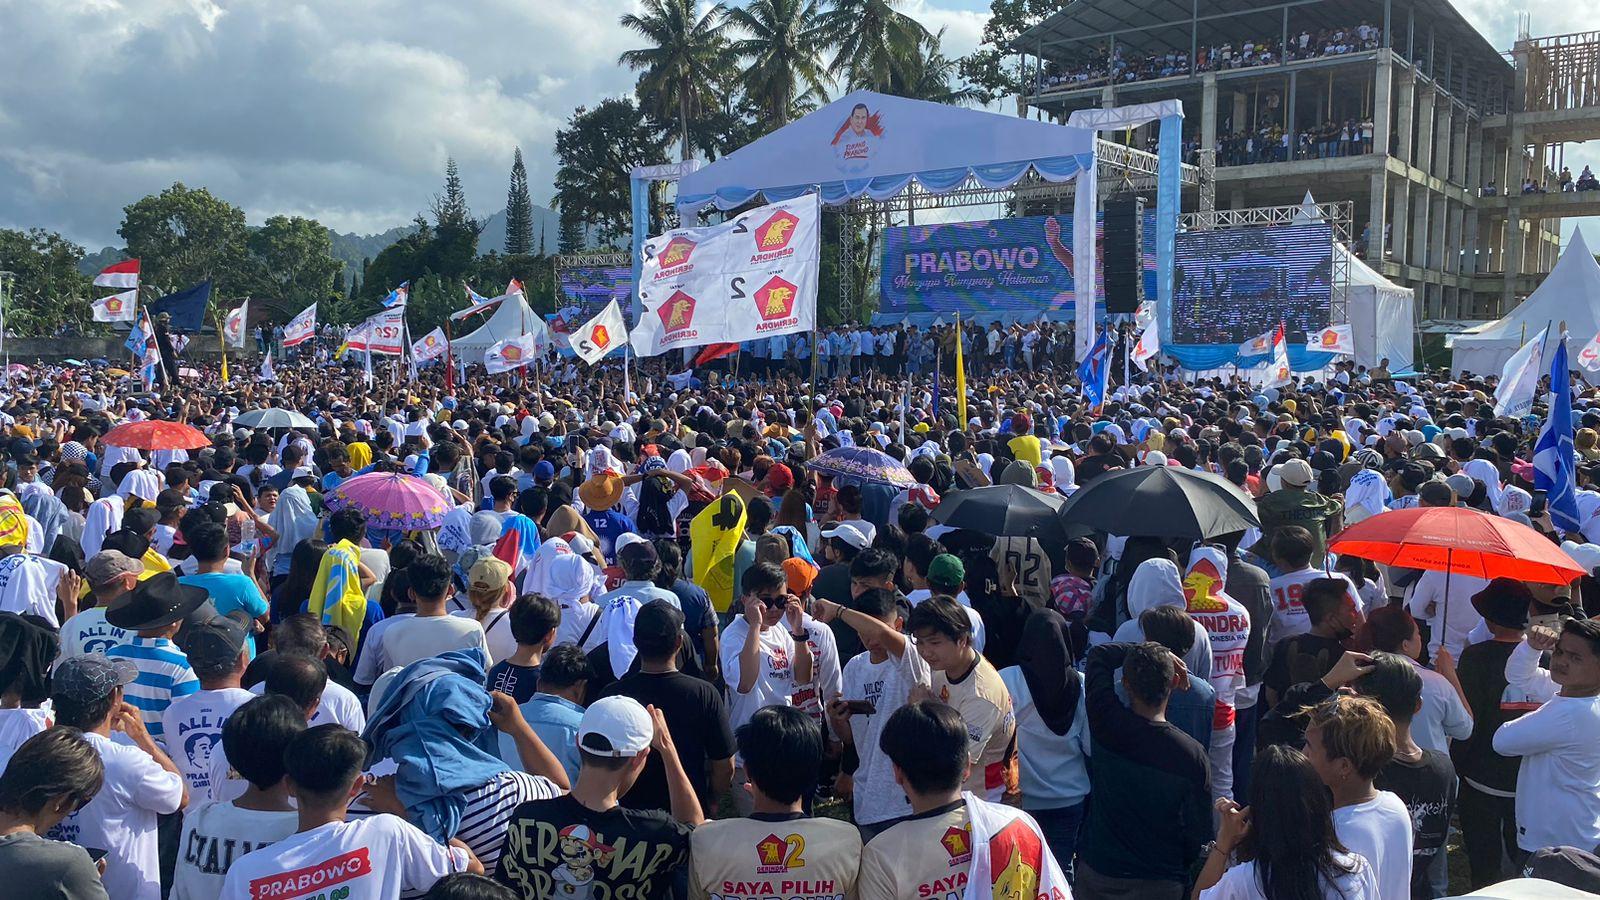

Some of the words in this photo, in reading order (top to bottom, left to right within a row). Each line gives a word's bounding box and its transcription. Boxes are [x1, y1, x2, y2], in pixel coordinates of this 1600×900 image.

[905, 247, 1039, 274] PRABOWO
[998, 269, 1049, 286] Halaman
[593, 518, 608, 529] 12
[80, 627, 107, 641] ALL
[110, 627, 126, 640] IN
[1208, 634, 1238, 642] ONESIA
[178, 716, 212, 737] ALL
[783, 833, 806, 868] 2
[258, 856, 362, 900] PRABOWO
[722, 881, 775, 896] SAYA
[781, 879, 835, 895] PILIH
[918, 871, 969, 898] SAYA
